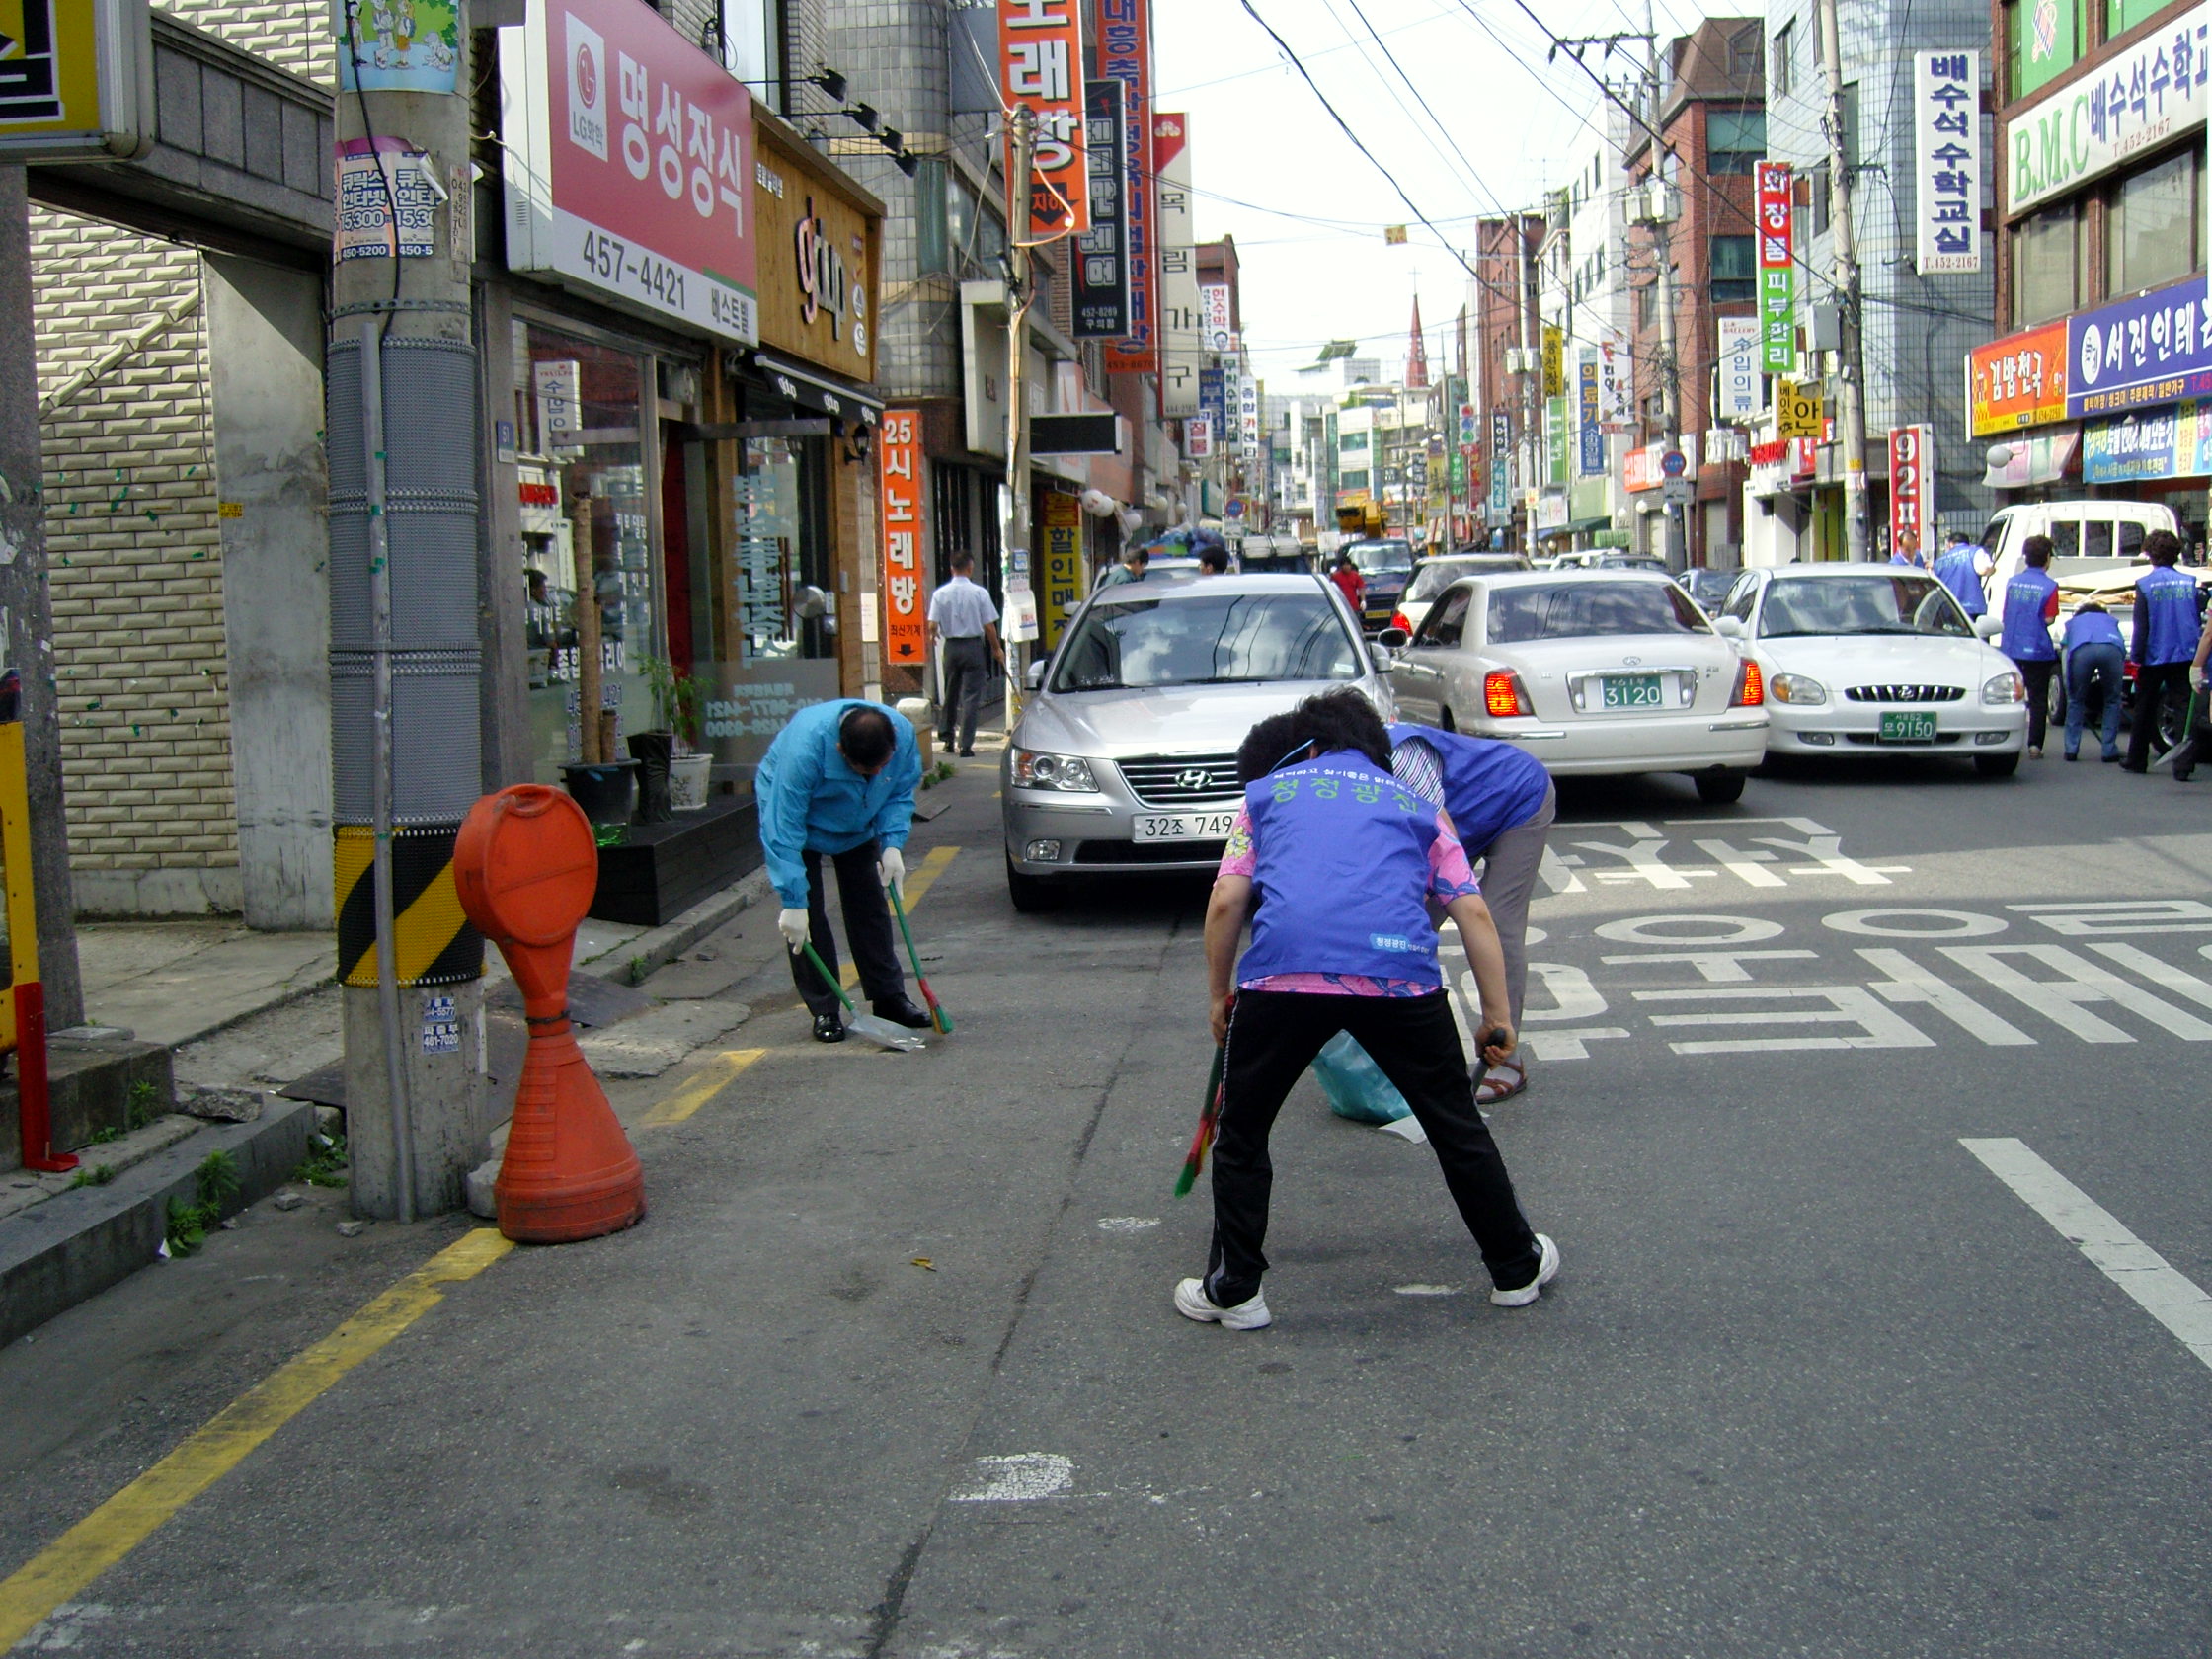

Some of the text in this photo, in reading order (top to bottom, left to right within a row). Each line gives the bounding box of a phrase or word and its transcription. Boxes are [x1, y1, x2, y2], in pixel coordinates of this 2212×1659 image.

[573, 111, 604, 152] LG화학
[619, 50, 742, 238] 명성장식
[2014, 93, 2090, 203] B.M.C
[2112, 118, 2172, 158] T.452-2167
[342, 170, 386, 191] 큐릭스
[342, 189, 388, 210] 인터넷
[340, 210, 386, 231] 15,300
[1764, 170, 1789, 263] 화장품
[342, 245, 433, 257] 450-5200 450-5
[583, 231, 685, 311] 457-4421
[1923, 256, 1978, 269] T.452-2167
[1212, 288, 1226, 329] 현수막
[1766, 272, 1790, 369] 피부관리
[1733, 337, 1753, 412] 수입의류
[1989, 350, 2043, 403] 김밥천국
[1606, 686, 1660, 725] 3120
[1896, 721, 1933, 738] 9150
[1270, 777, 1418, 815] 청정광진
[1146, 818, 1184, 836] 32조
